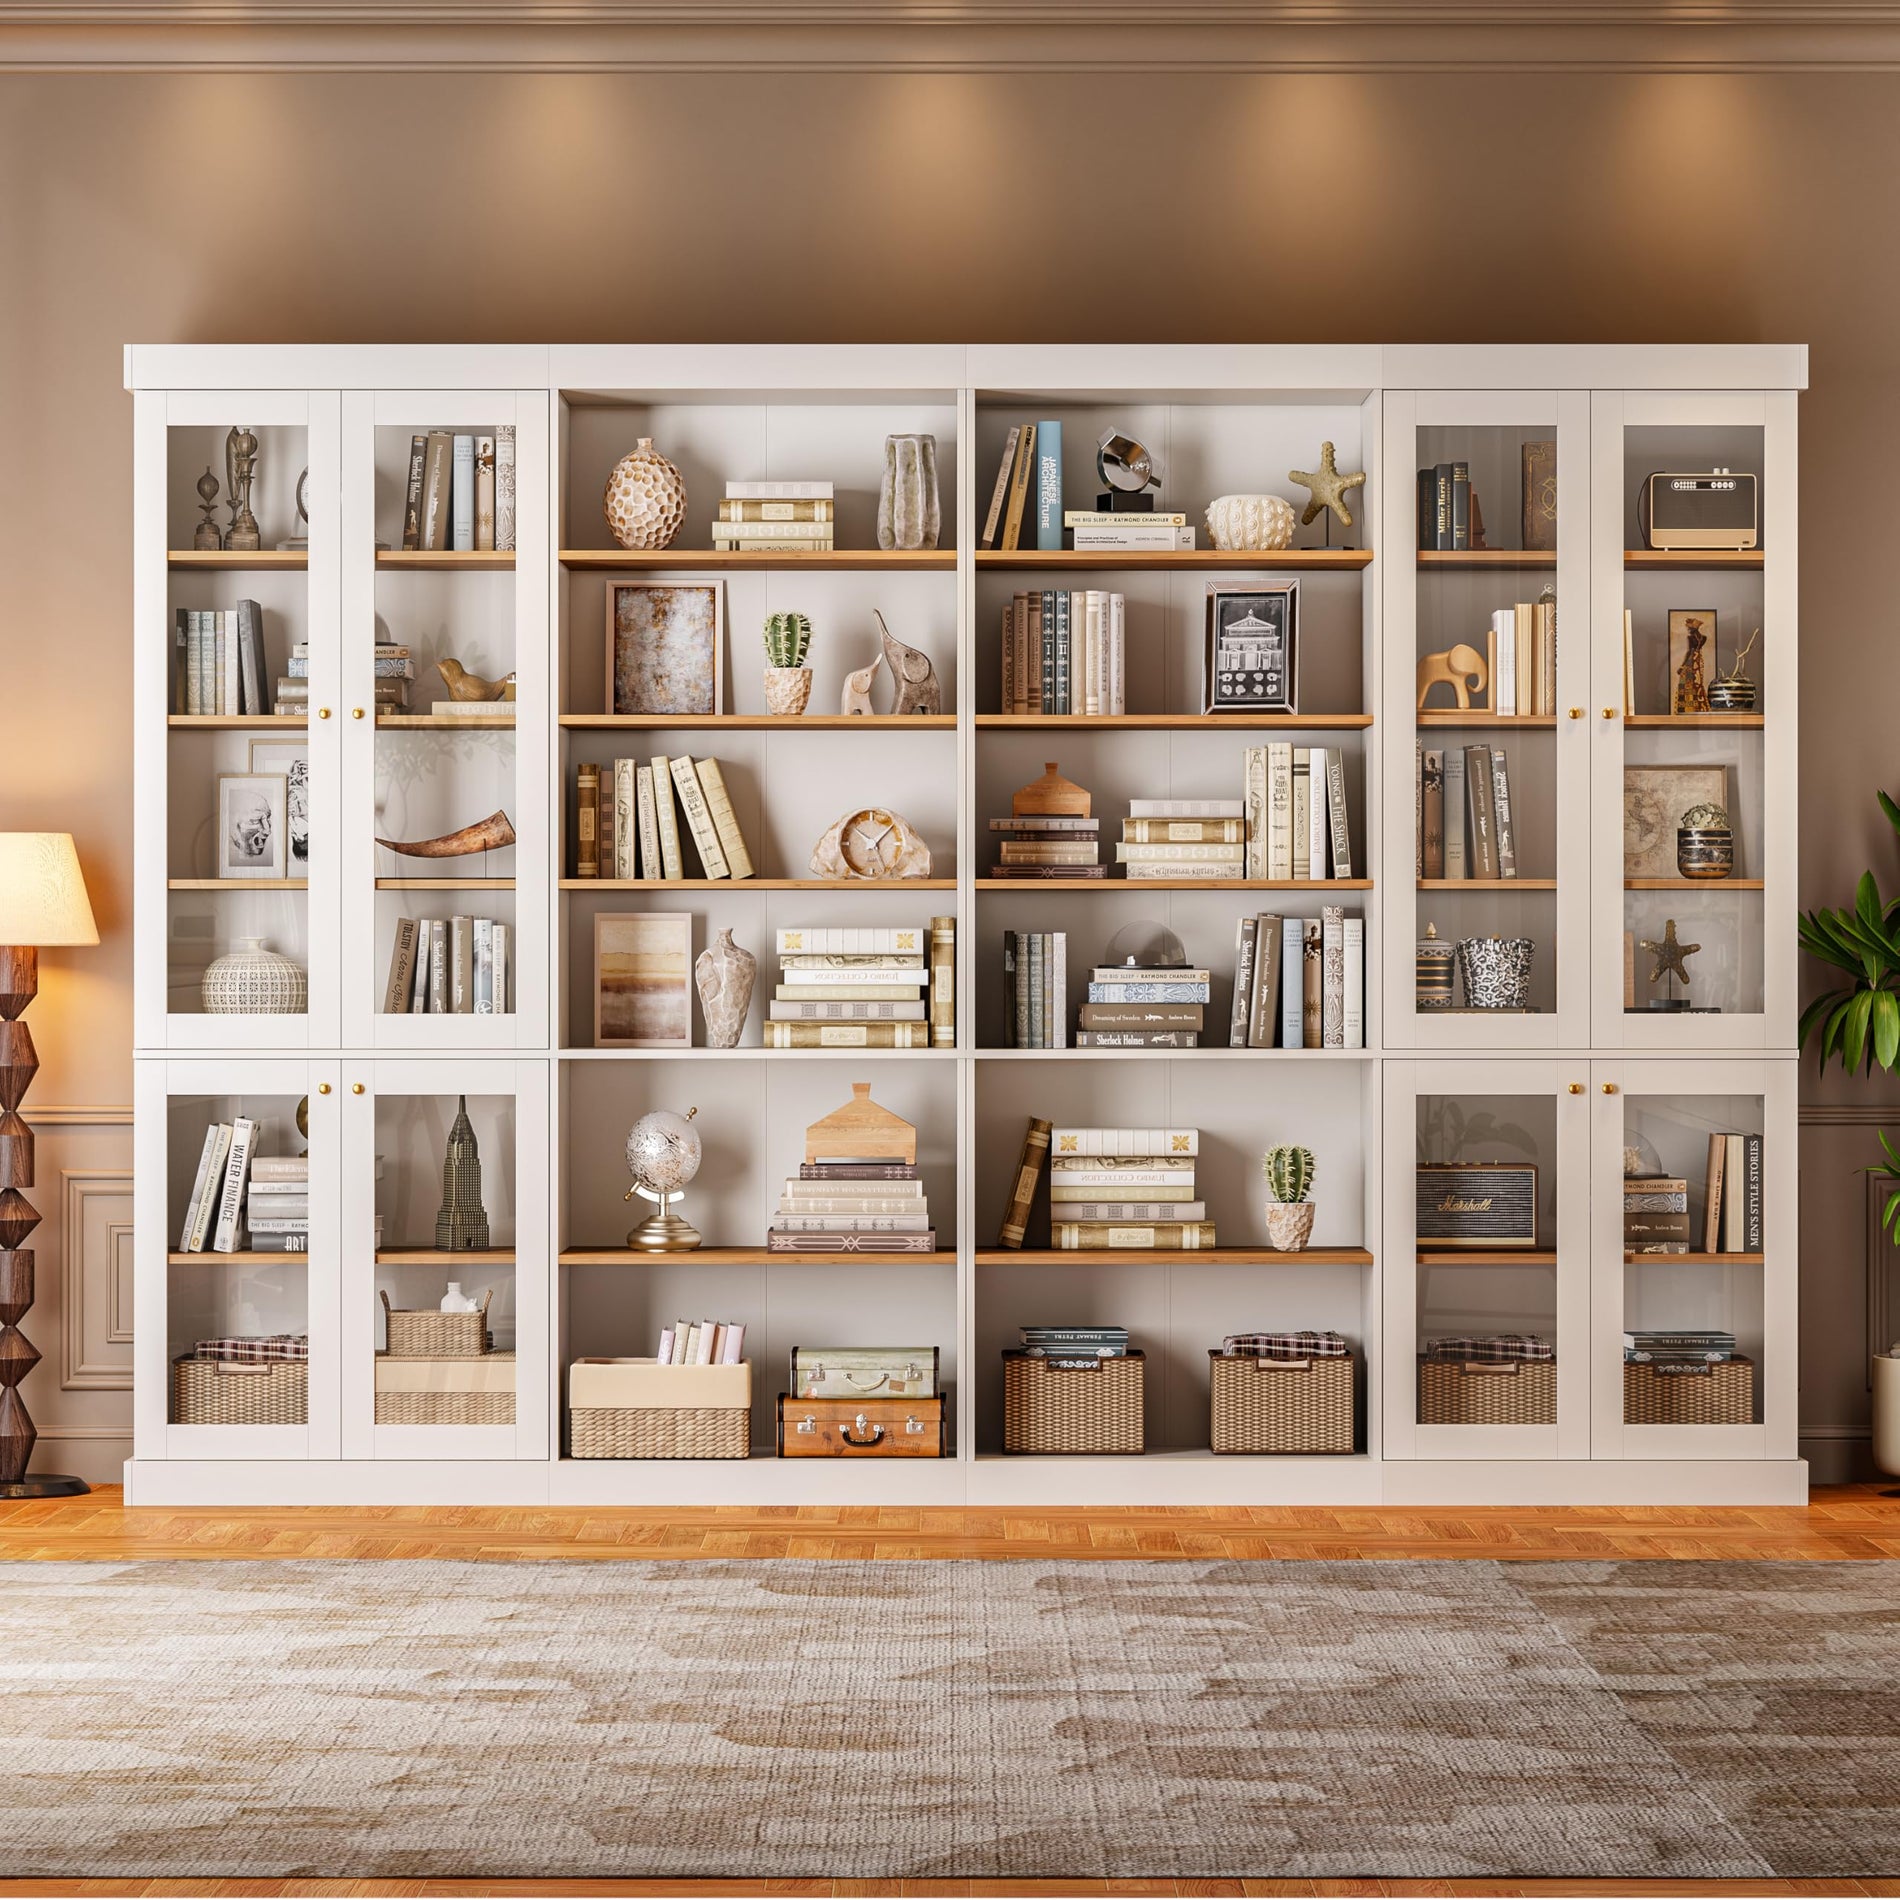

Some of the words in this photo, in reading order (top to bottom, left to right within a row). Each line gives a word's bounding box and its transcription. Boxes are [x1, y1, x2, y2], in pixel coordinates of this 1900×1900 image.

[411, 455, 423, 480] Sherlock
[1048, 456, 1057, 505] JAPANESE
[408, 481, 420, 503] Holmes
[1041, 456, 1049, 529] ARCHITECTURE
[1438, 477, 1446, 505] Harris
[1438, 505, 1446, 534] Miller
[294, 705, 308, 715] Sher
[1330, 763, 1342, 796] YOUNG
[1332, 804, 1344, 824] THE
[1335, 824, 1347, 854] SHACK
[401, 922, 414, 951] TOLSTOY
[396, 951, 408, 981] Anna
[433, 940, 443, 969] Sherlock
[1241, 940, 1253, 968] Sherlock
[433, 969, 443, 990] Holmes
[1239, 968, 1251, 991] Holmes
[391, 983, 403, 1014] Kare
[1092, 1014, 1116, 1022] Dreaming
[1096, 1034, 1122, 1046] Sherlock
[1122, 1034, 1145, 1046] Holmes
[229, 1144, 245, 1177] WATER
[1750, 1140, 1759, 1182] STORIES
[204, 1174, 215, 1204] RAYMOND
[222, 1178, 239, 1223] FINANCE
[1437, 1195, 1492, 1211] Marshall
[1750, 1183, 1759, 1215] STYLE
[197, 1205, 207, 1235] CHANDLER
[1750, 1216, 1759, 1247] MEN'S
[284, 1235, 306, 1252] ART
